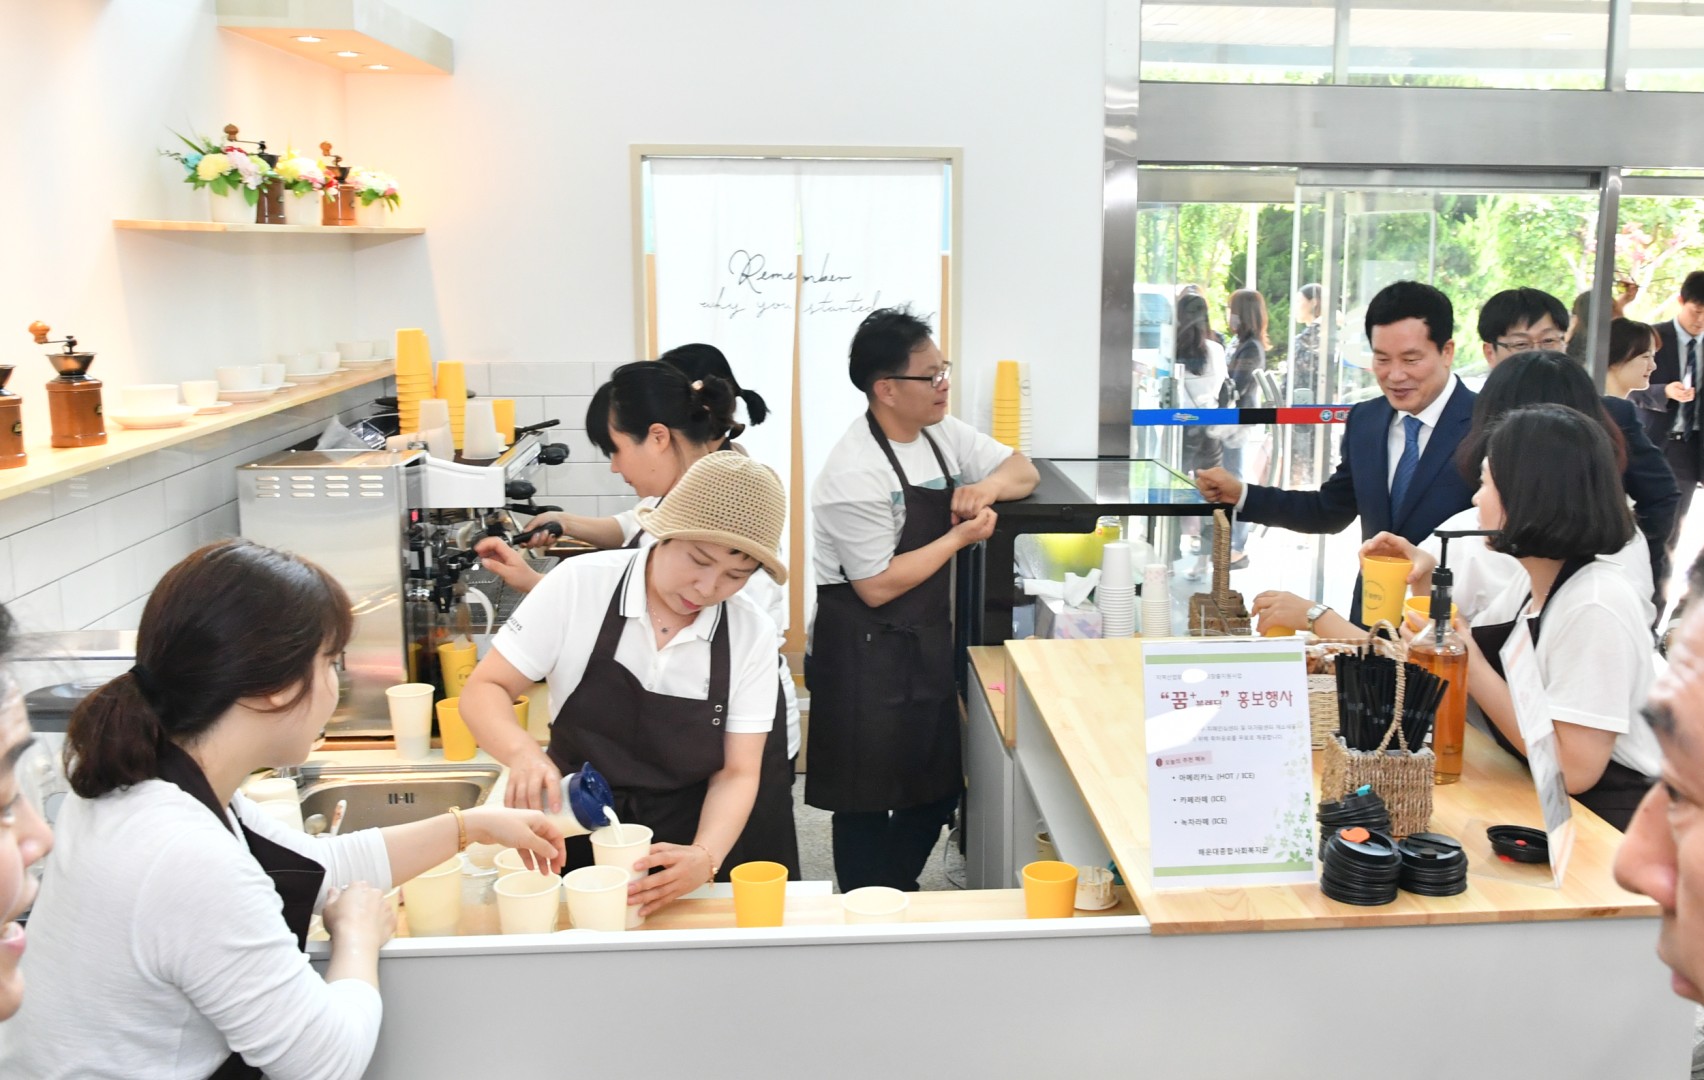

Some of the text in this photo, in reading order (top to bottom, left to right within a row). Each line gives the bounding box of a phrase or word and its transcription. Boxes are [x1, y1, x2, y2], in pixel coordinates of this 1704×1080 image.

[728, 249, 852, 294] Remember
[700, 287, 881, 319] why you started
[1237, 690, 1293, 710] 홍보행사
[1178, 773, 1214, 782] 아메리카노
[1216, 772, 1234, 780] (HOT
[1241, 772, 1256, 780] ICE)
[1210, 795, 1227, 803] (ICE)
[1211, 817, 1228, 825] (ICE)
[1198, 846, 1269, 857] 해운대종합사회복지관
